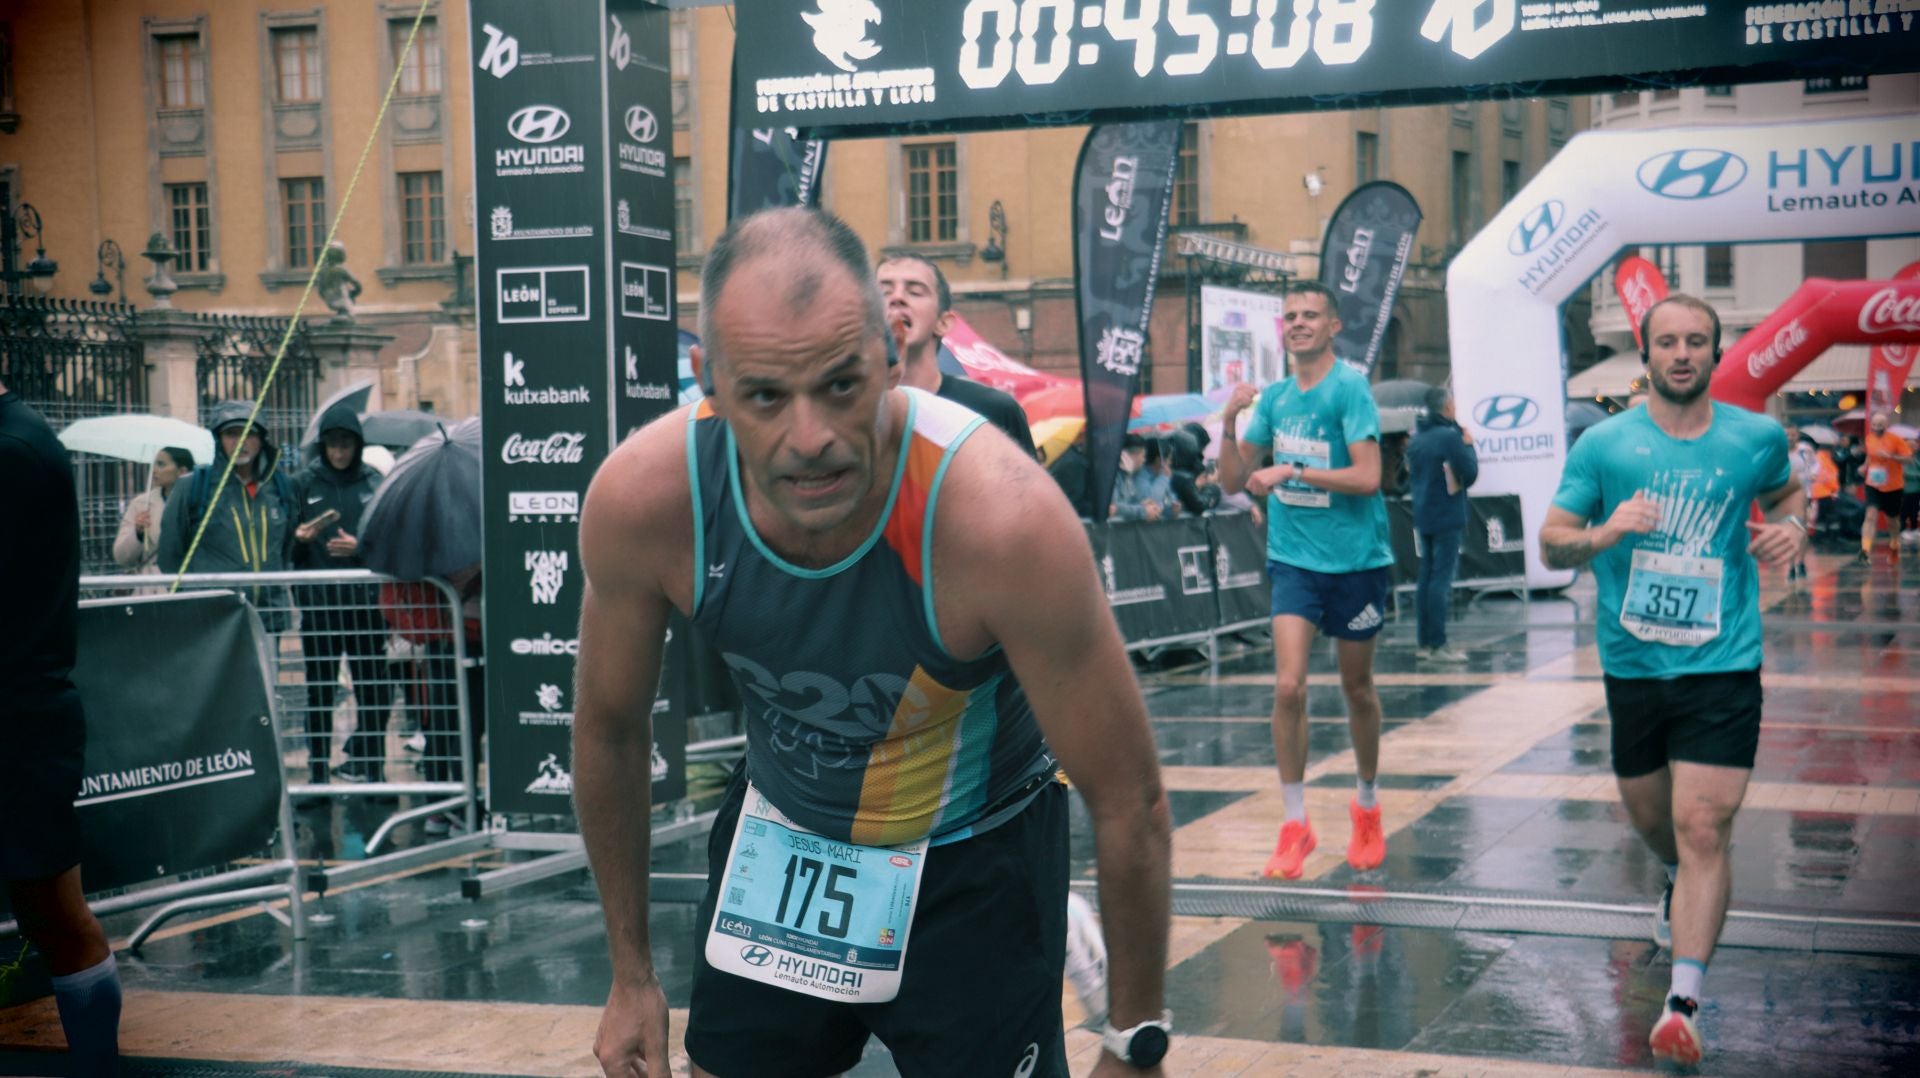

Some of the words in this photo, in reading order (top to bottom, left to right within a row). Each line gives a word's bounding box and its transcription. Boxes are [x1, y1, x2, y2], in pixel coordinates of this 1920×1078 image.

[1745, 25, 1773, 45] DE
[1782, 15, 1890, 42] CASTILLA
[1900, 12, 1913, 31] Y
[958, 0, 1376, 89] 00:45:08
[757, 95, 779, 113] DE
[785, 89, 866, 111] CASTILLA
[871, 87, 883, 106] Y
[495, 145, 584, 167] HYUNDAI
[619, 143, 666, 169] HYUNDAI
[1768, 141, 1920, 189] HYU
[1767, 189, 1888, 213] Lemauto
[1897, 187, 1920, 206] A
[1518, 208, 1600, 289] HYUNDAI
[503, 284, 540, 303] LEÓN
[624, 281, 644, 298] LEÓN
[503, 351, 526, 387] k
[504, 385, 590, 405] kutxabank
[625, 381, 671, 400] kutxabank
[1476, 434, 1553, 453] YUNDAI
[513, 496, 575, 510] LEON
[508, 514, 579, 523] PLAZA
[1645, 583, 1699, 620] 357
[186, 757, 203, 777] DE
[206, 748, 252, 773] LEÓN
[787, 835, 821, 854] JESUS
[828, 844, 864, 864] MARI
[775, 854, 857, 938] 175
[774, 970, 809, 986] Lemauto
[809, 980, 861, 997] Automoción
[777, 954, 864, 988] HYUNDAI
